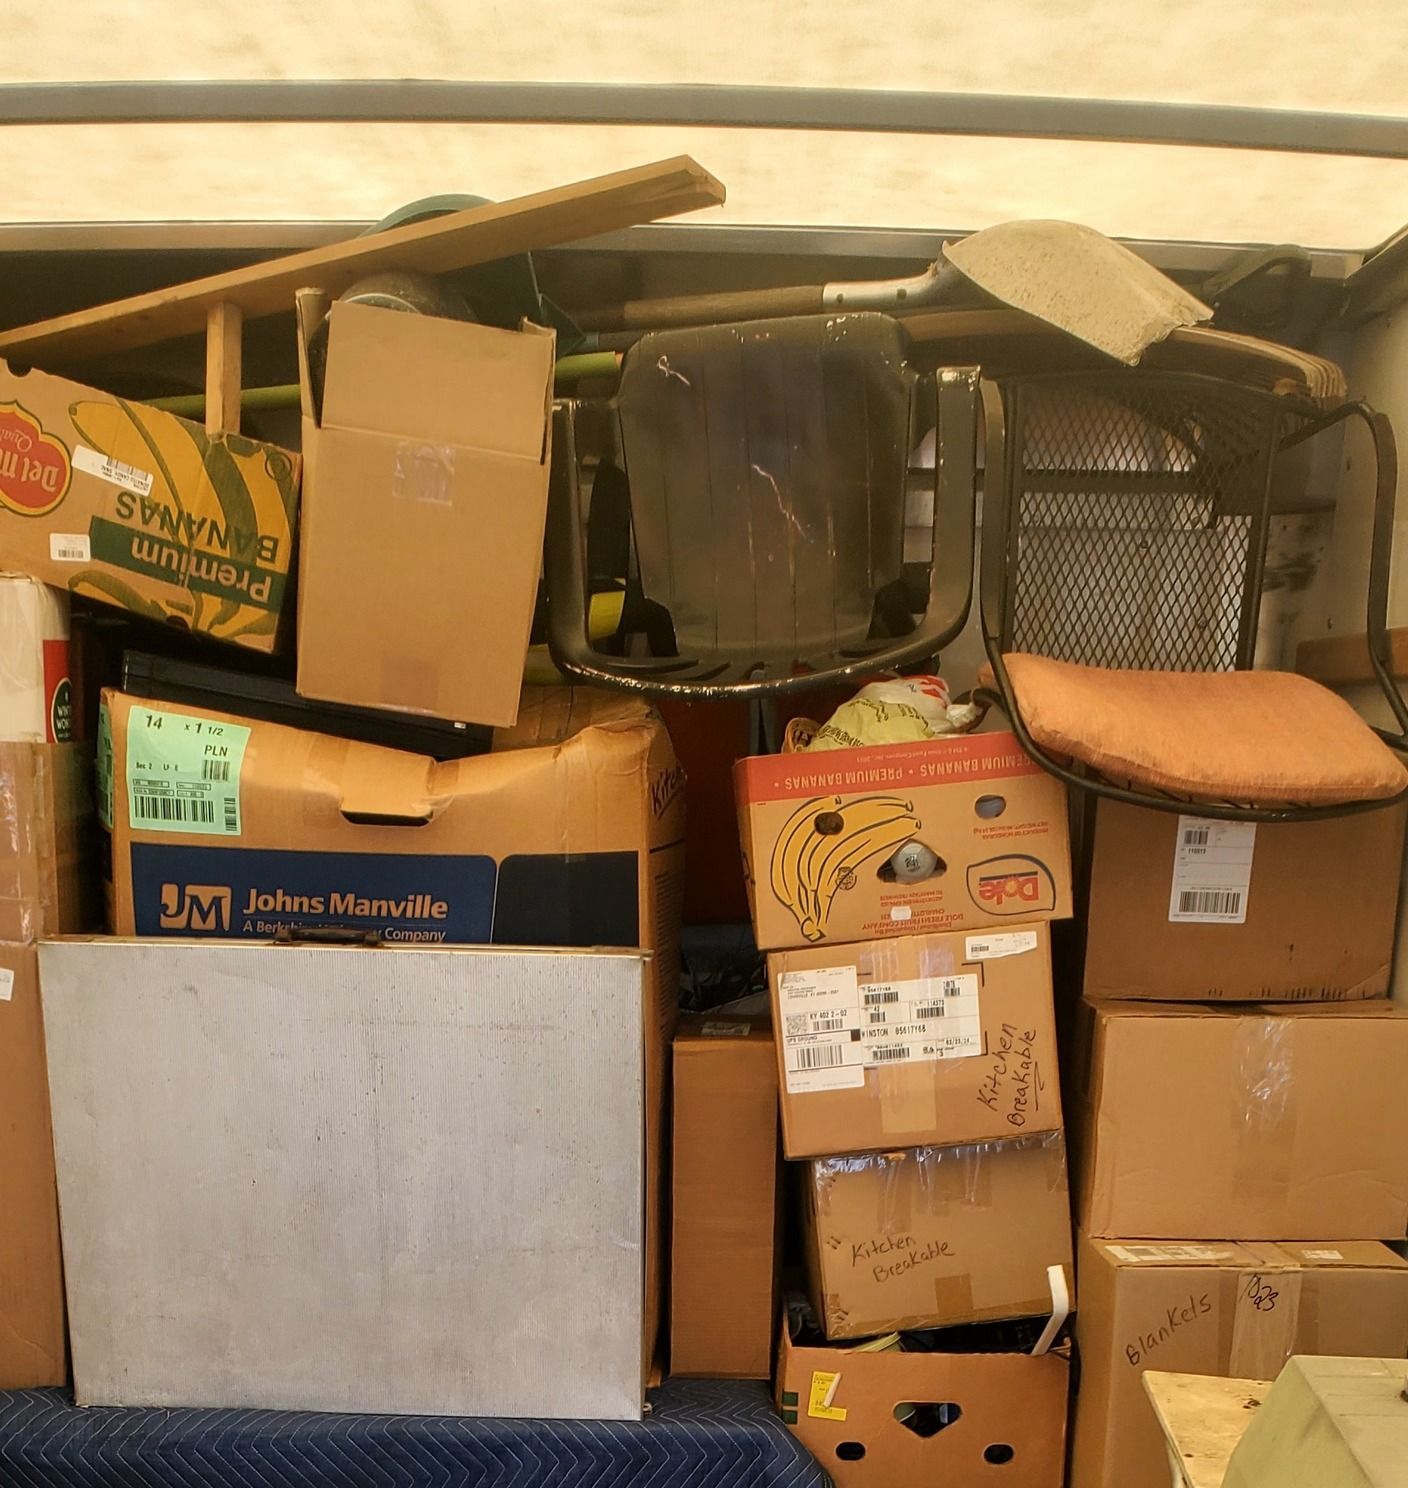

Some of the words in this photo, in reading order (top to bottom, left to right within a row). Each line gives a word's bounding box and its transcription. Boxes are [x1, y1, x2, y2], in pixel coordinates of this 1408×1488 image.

[21, 457, 59, 493] Del
[116, 490, 280, 564] BANANAS
[131, 536, 272, 604] Premium
[146, 714, 163, 730] 14
[203, 744, 229, 758] PLN
[784, 772, 843, 791] BANANAS
[845, 766, 903, 785] PREMIUM
[919, 759, 979, 778] BANANAS
[242, 887, 325, 915] Johns
[328, 892, 450, 920] Manville
[978, 877, 1040, 906] Dole
[160, 882, 232, 931] JM
[242, 919, 253, 933] A
[384, 927, 447, 943] Company
[809, 1012, 818, 1020] KY
[861, 1028, 889, 1038] WINSTON
[977, 1022, 1018, 1112] Kitchen
[851, 1233, 917, 1268] Kitchen
